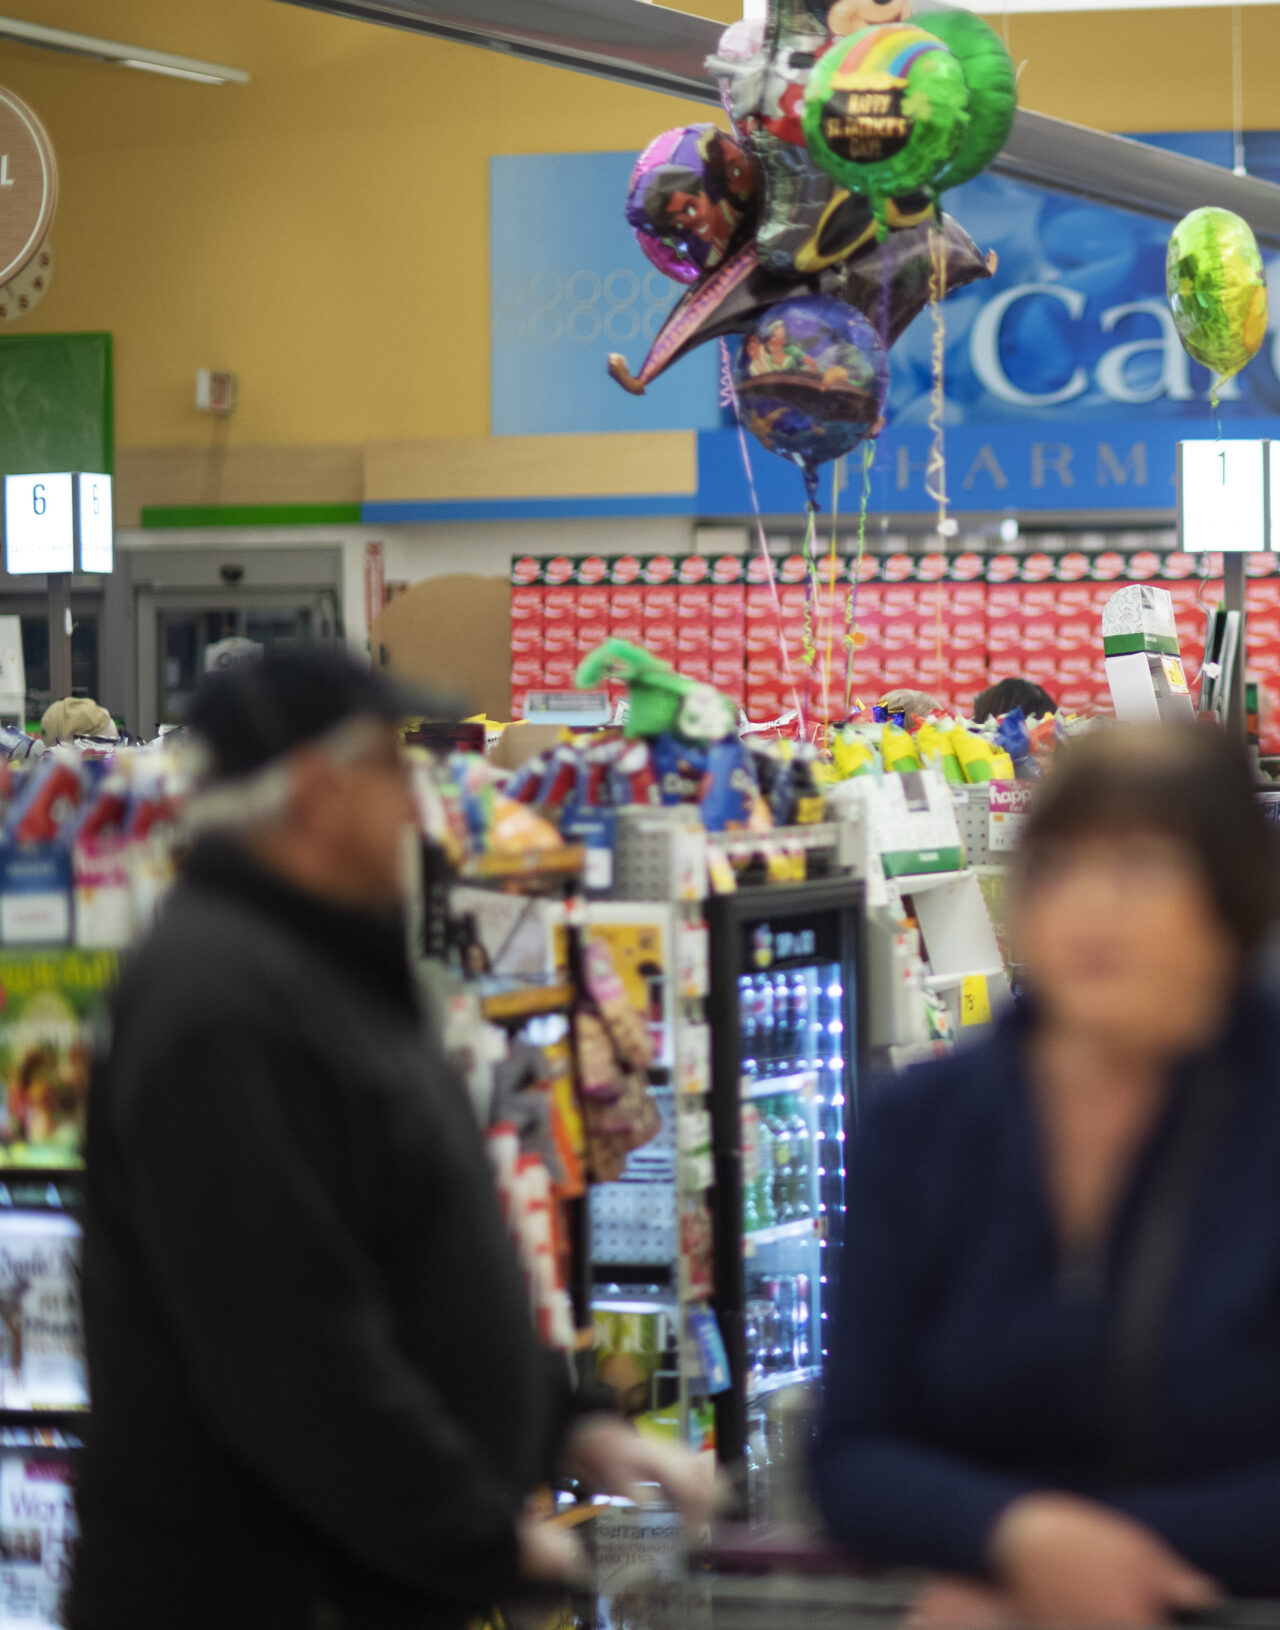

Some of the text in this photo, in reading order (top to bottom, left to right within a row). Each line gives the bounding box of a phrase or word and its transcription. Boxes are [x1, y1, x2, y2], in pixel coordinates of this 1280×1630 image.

[1216, 450, 1227, 487] 1
[32, 483, 47, 516] 6
[988, 784, 1032, 807] happ
